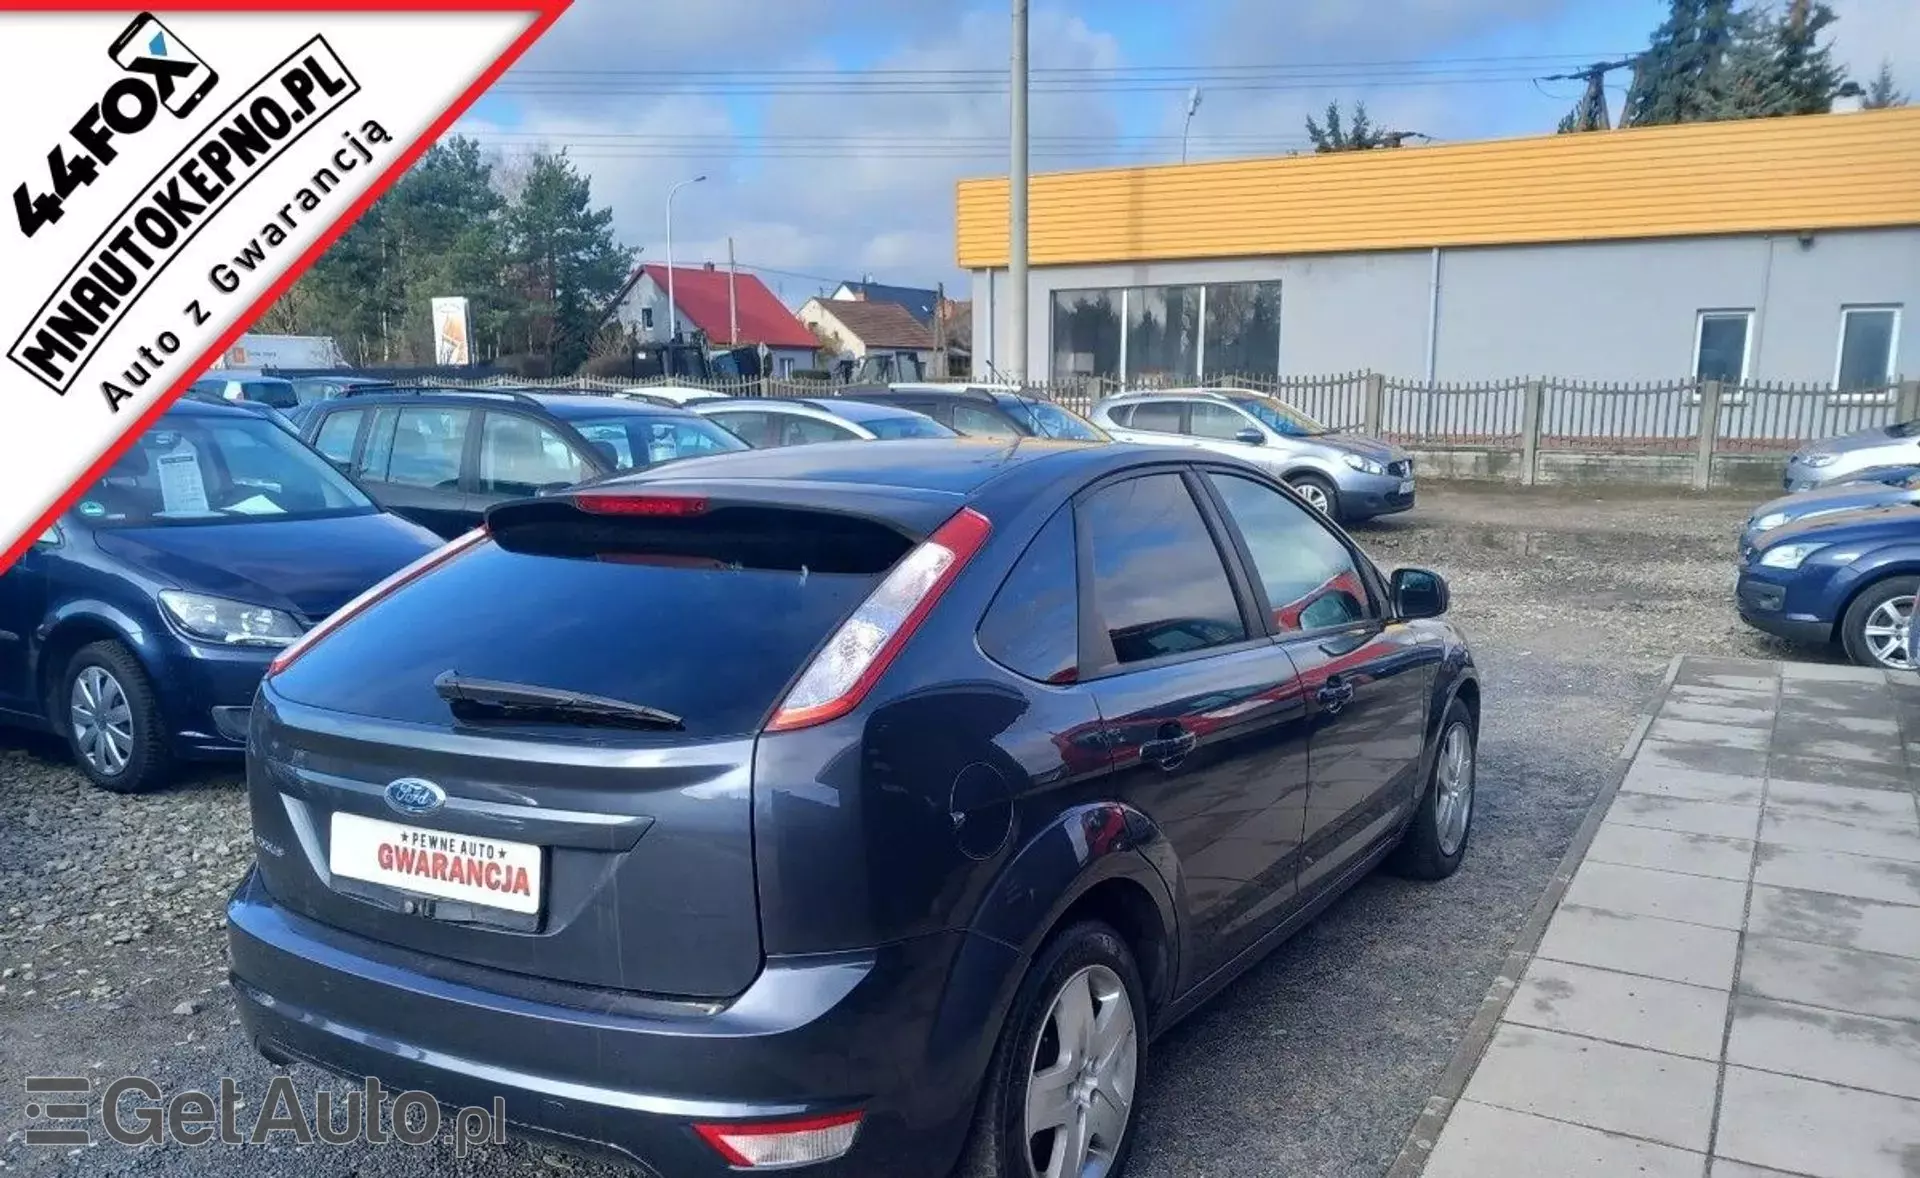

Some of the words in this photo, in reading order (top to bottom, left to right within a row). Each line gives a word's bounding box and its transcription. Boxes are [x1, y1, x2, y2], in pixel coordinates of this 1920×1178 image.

[412, 831, 455, 851] PEWNE
[460, 841, 494, 859] AUTO
[377, 843, 531, 897] GWARANCJA
